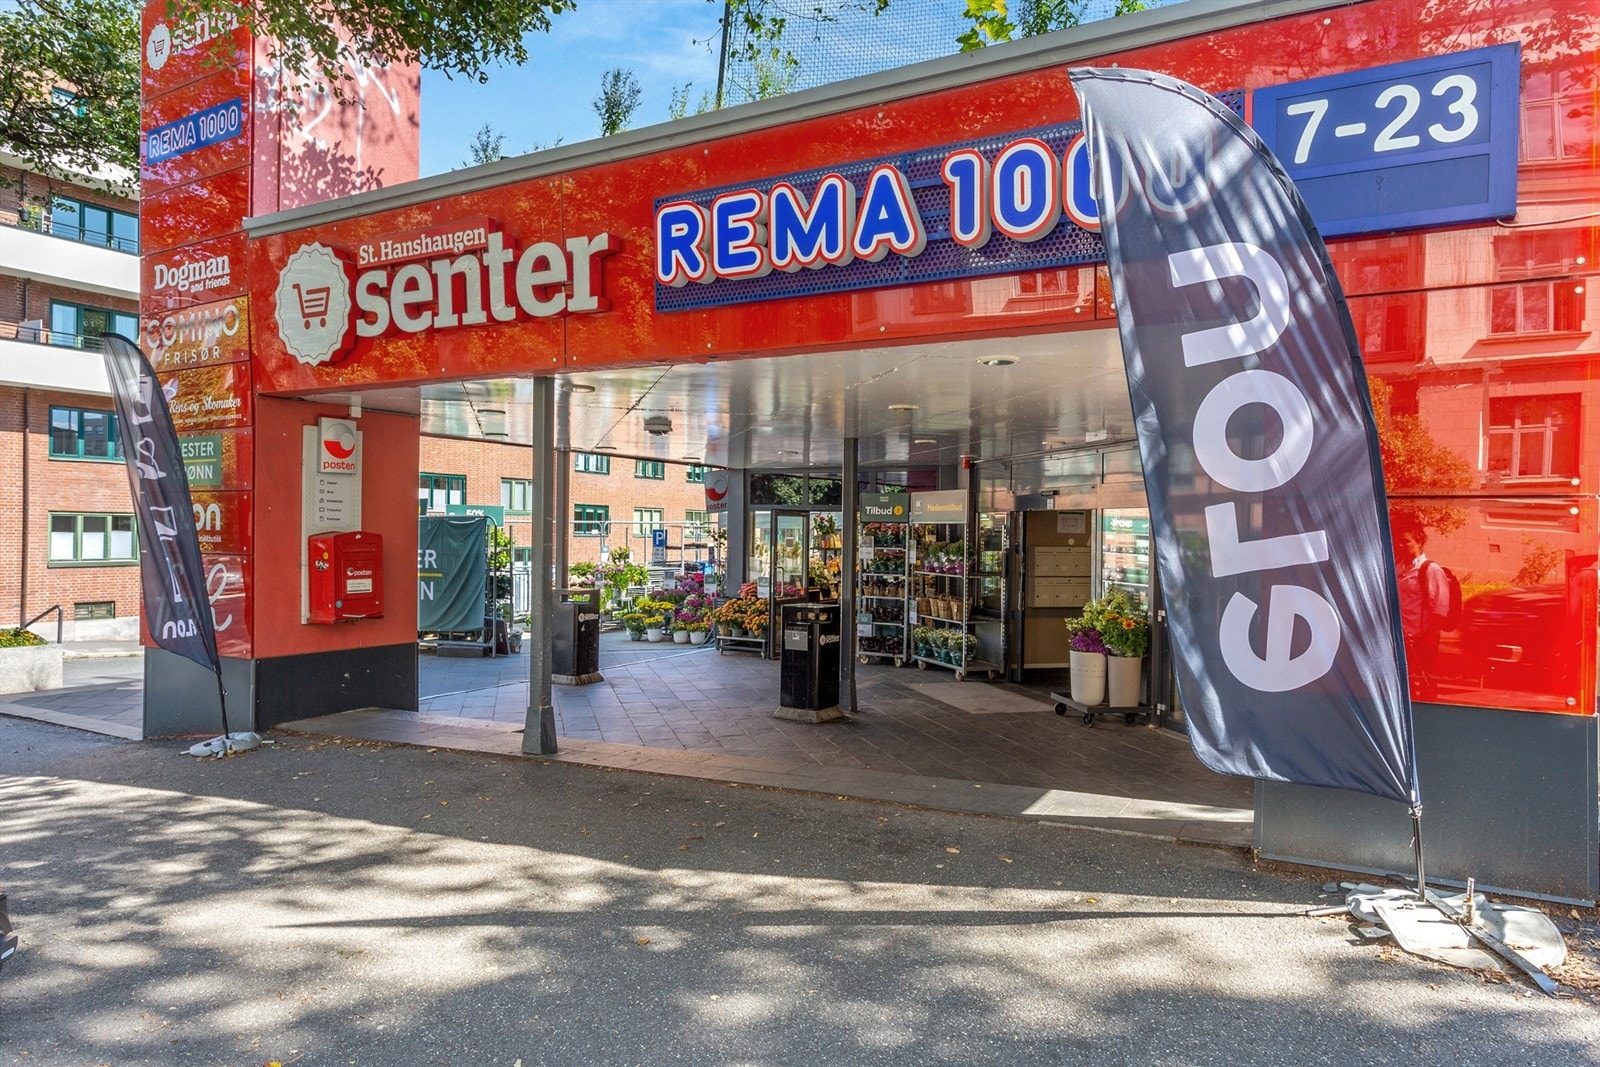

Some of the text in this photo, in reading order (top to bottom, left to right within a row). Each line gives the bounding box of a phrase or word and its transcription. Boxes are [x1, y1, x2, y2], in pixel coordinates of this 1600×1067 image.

[148, 106, 239, 158] REMA 1000
[1287, 75, 1479, 164] 7-23
[655, 164, 920, 286] REMA
[359, 227, 487, 265] St. Hanshaugen
[154, 255, 231, 292] Dogman
[190, 276, 231, 293] and friends
[356, 231, 609, 338] senter
[147, 305, 240, 348] COMINO
[164, 346, 220, 366] FRISØR
[169, 393, 242, 415] Rens og Skomaker
[323, 460, 356, 472] posten
[865, 506, 893, 515] Tilbud
[656, 531, 664, 545] P
[353, 569, 372, 577] posten
